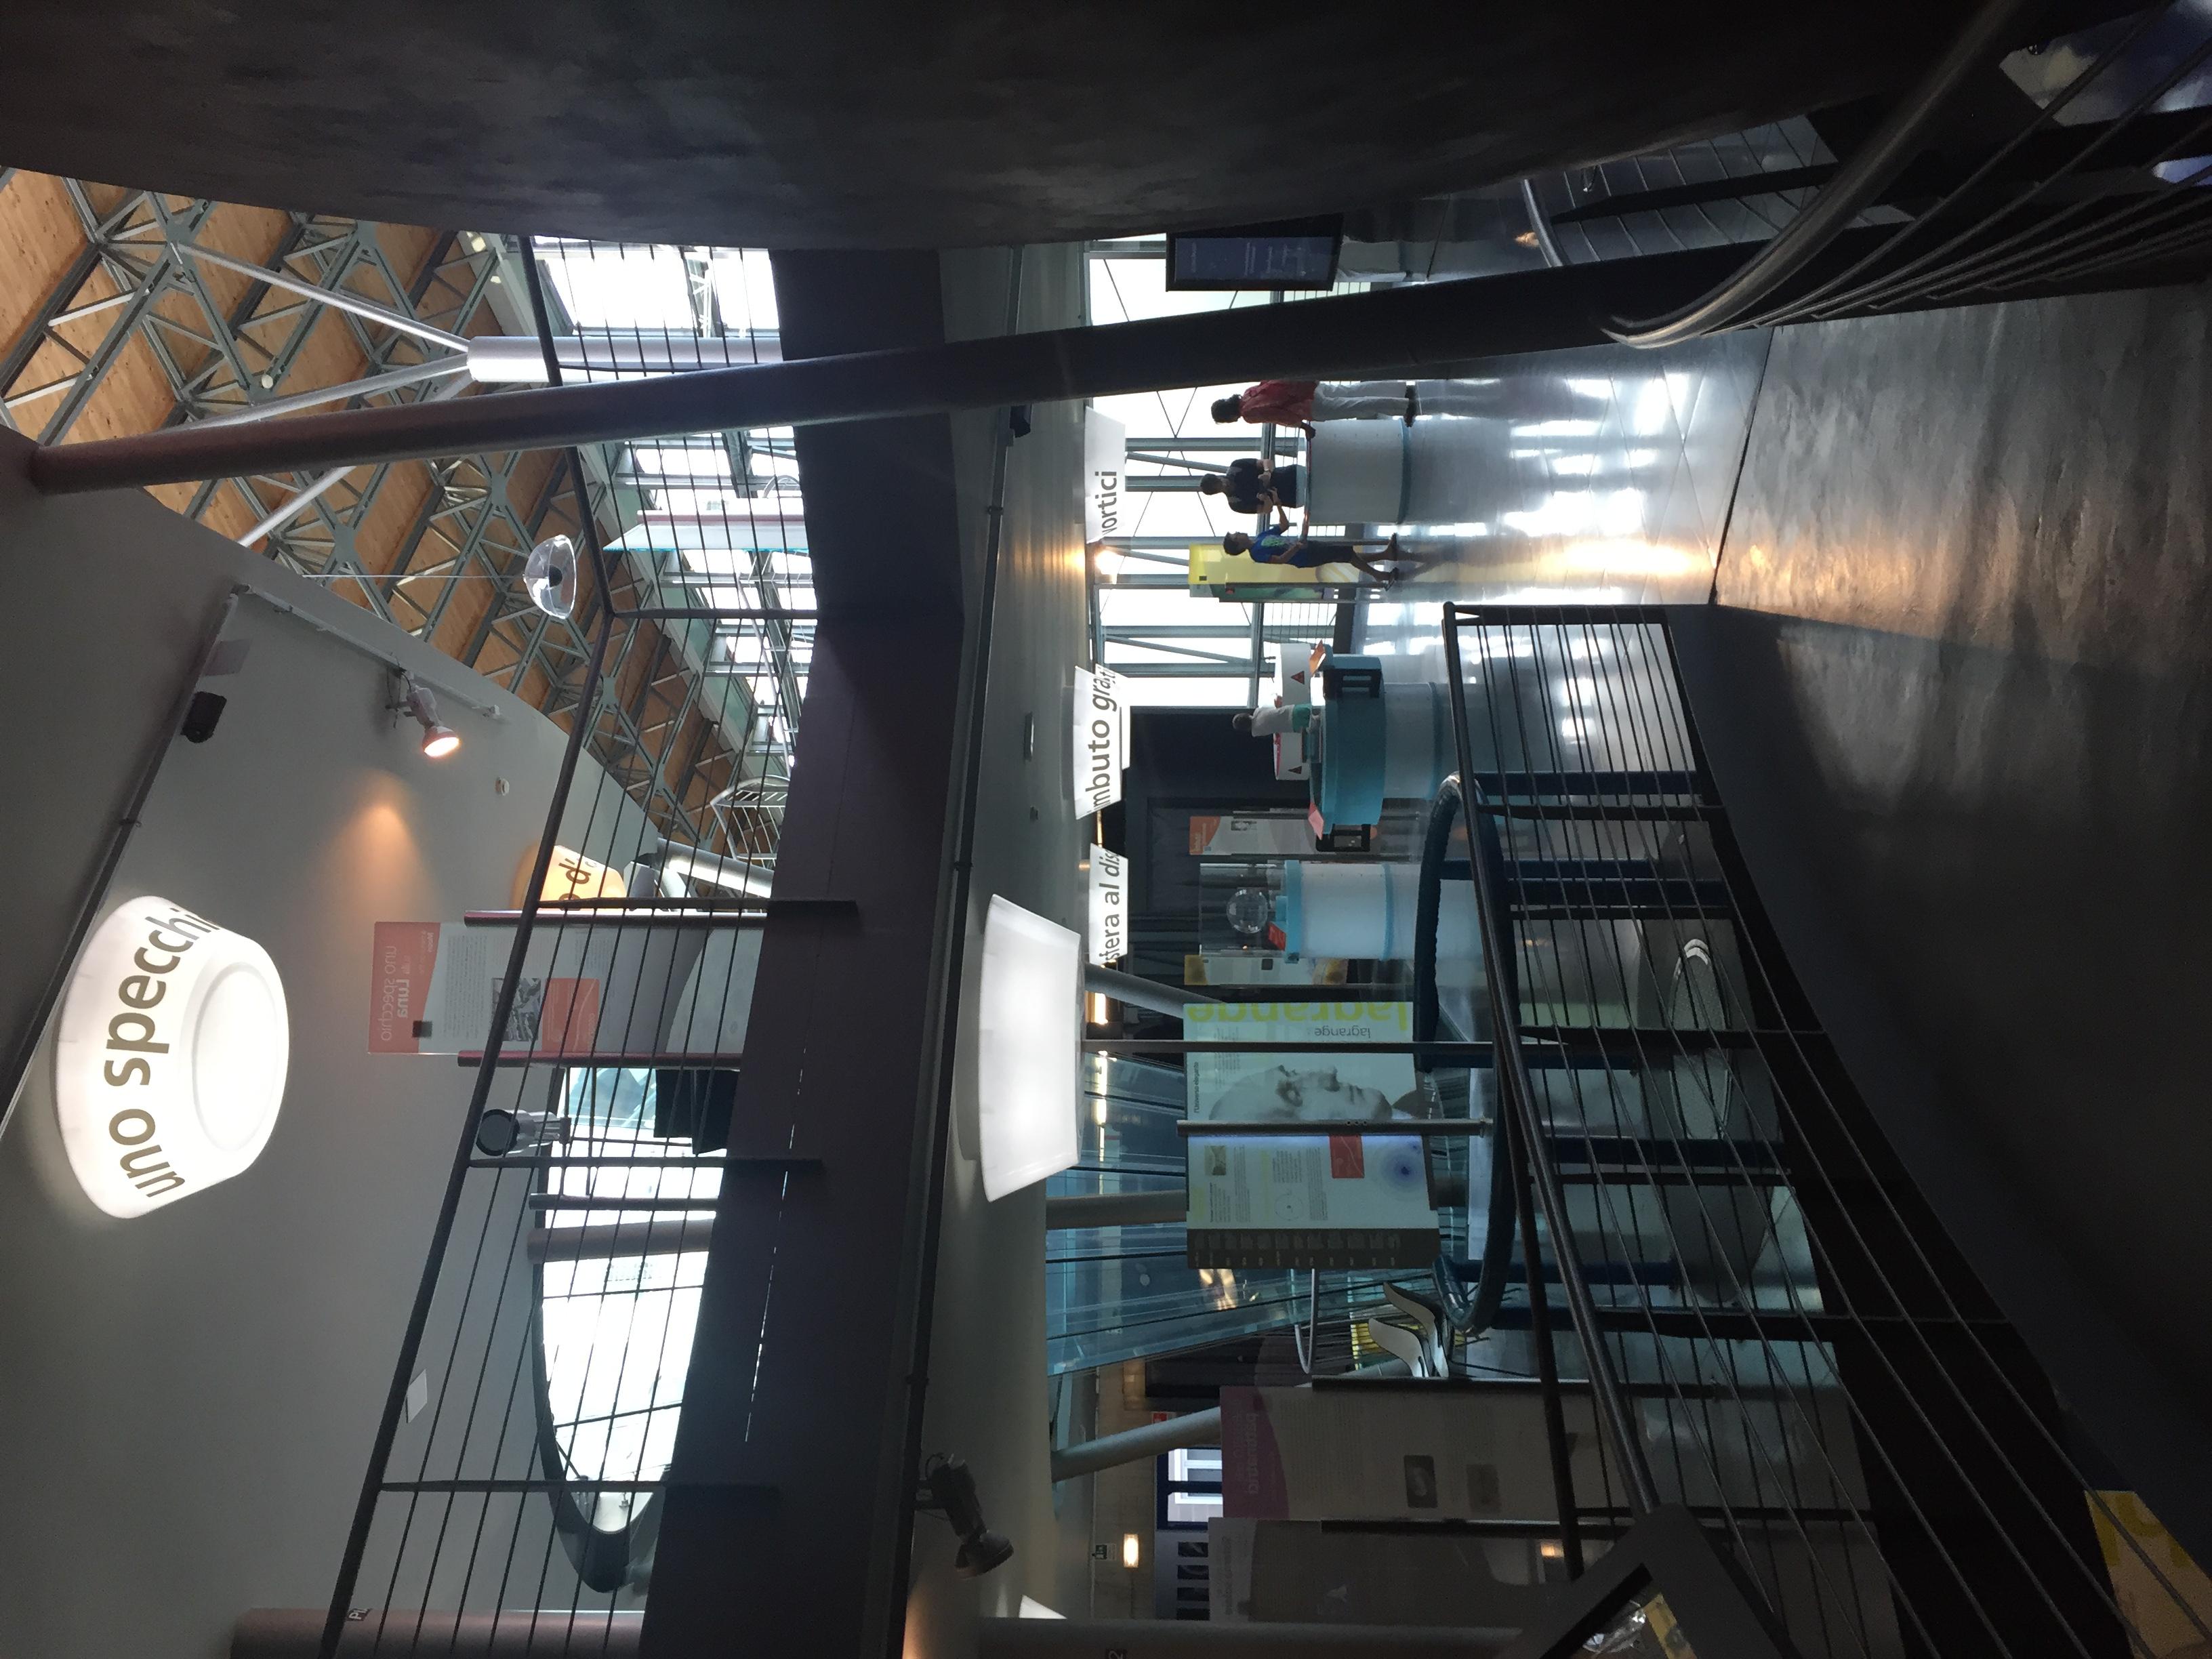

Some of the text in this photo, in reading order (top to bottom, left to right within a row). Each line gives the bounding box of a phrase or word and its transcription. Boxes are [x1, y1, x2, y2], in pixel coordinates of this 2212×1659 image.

[1099, 882, 1120, 906] al
[1099, 914, 1120, 960] sfera
[1314, 1025, 1371, 1038] lagrange
[108, 1109, 185, 1197] uno
